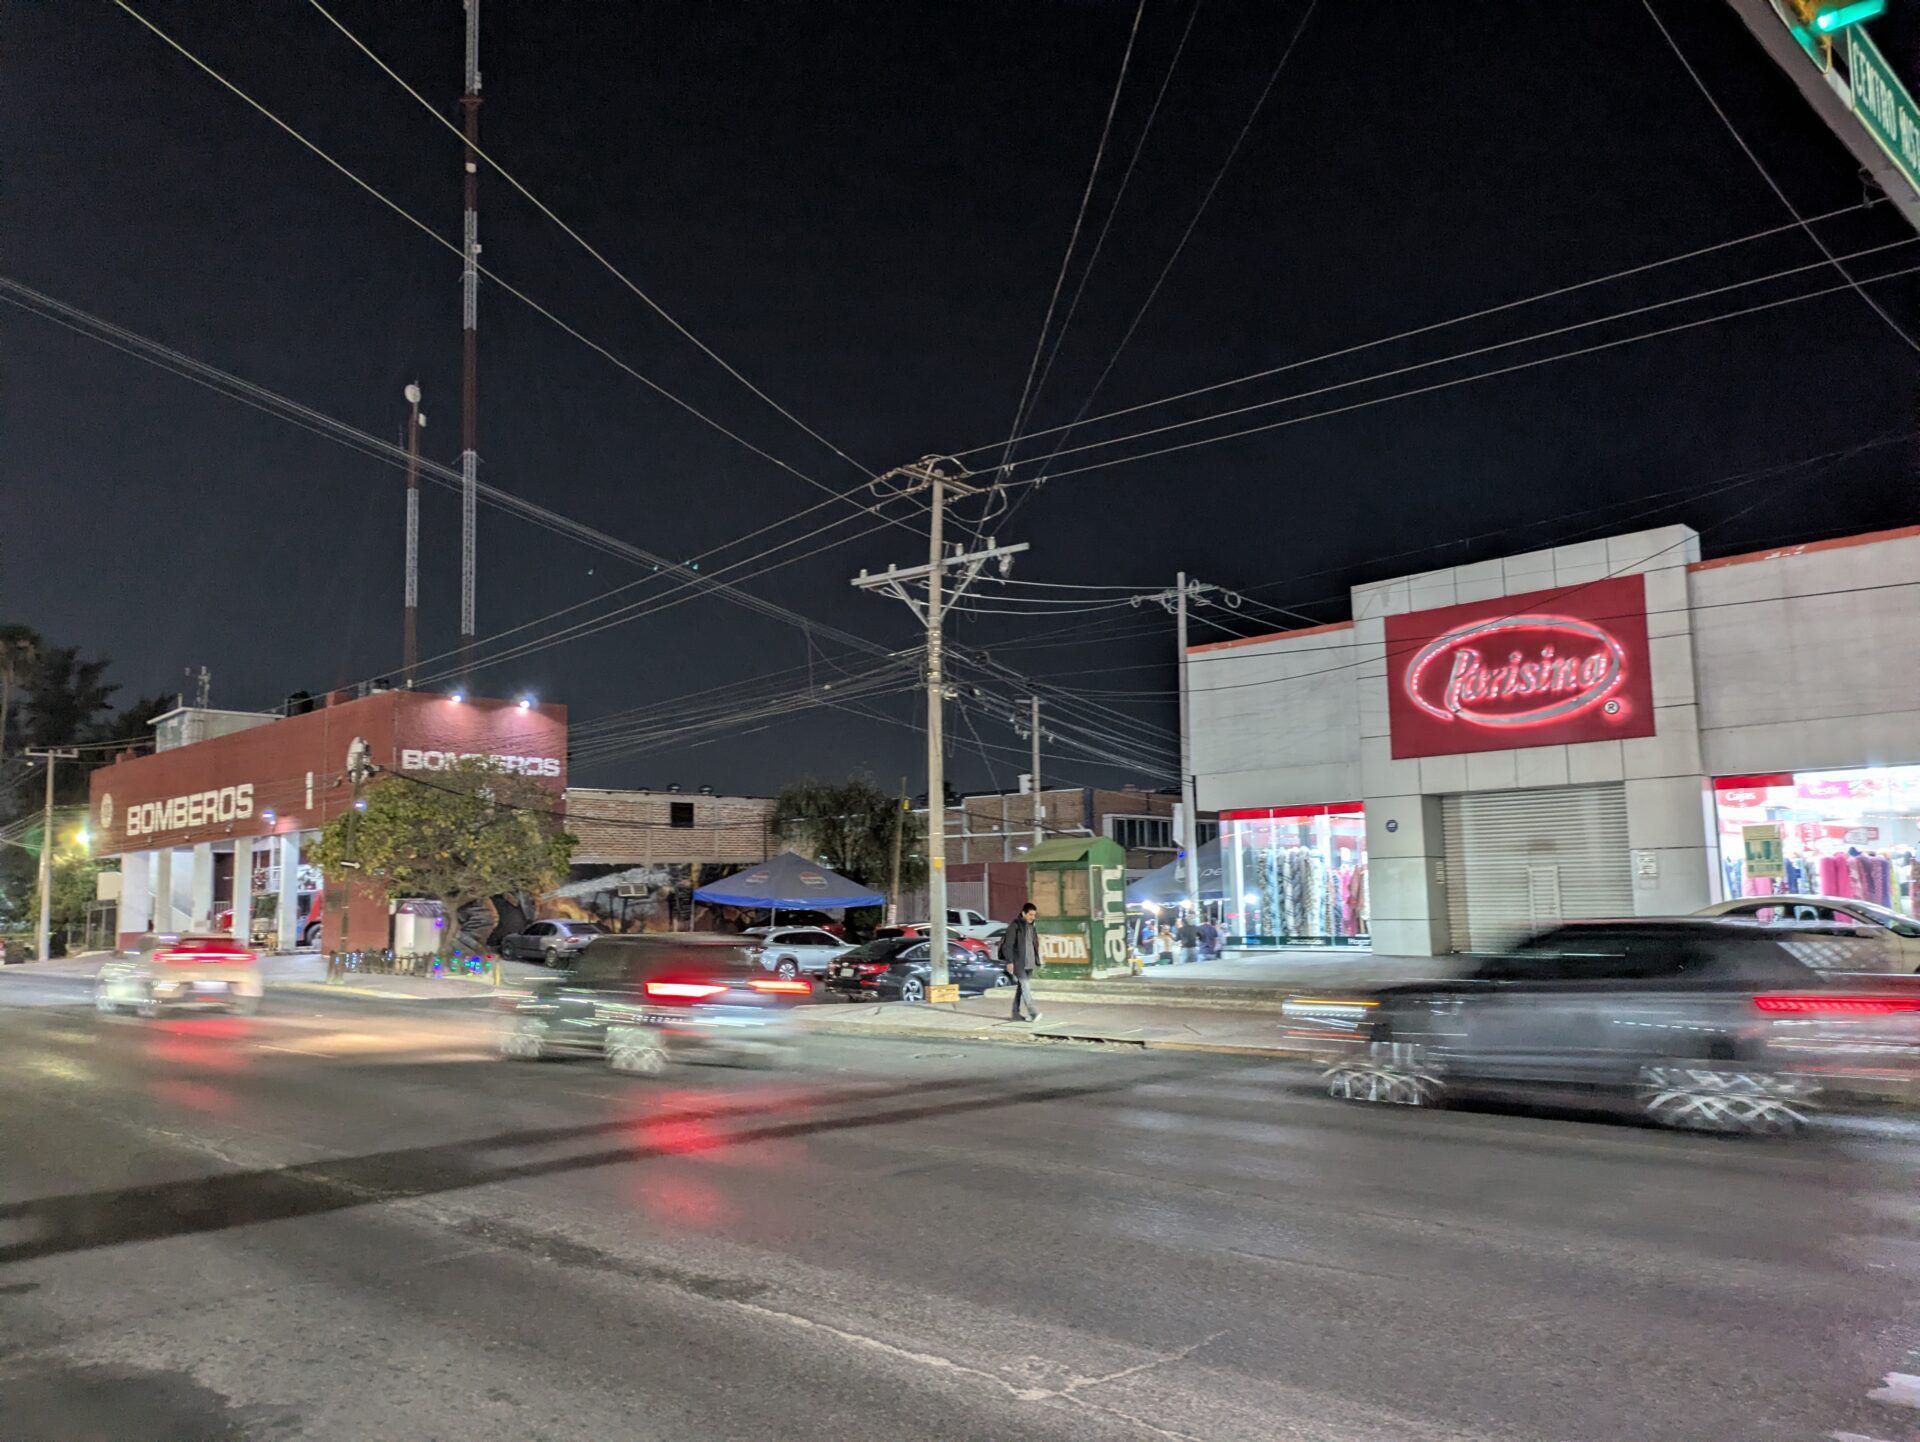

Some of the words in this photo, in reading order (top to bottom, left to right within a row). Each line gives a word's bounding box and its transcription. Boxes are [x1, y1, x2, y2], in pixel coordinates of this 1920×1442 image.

[1852, 41, 1897, 141] CENTRO
[1446, 645, 1607, 714] Parisina
[126, 784, 254, 836] BOMBEROS
